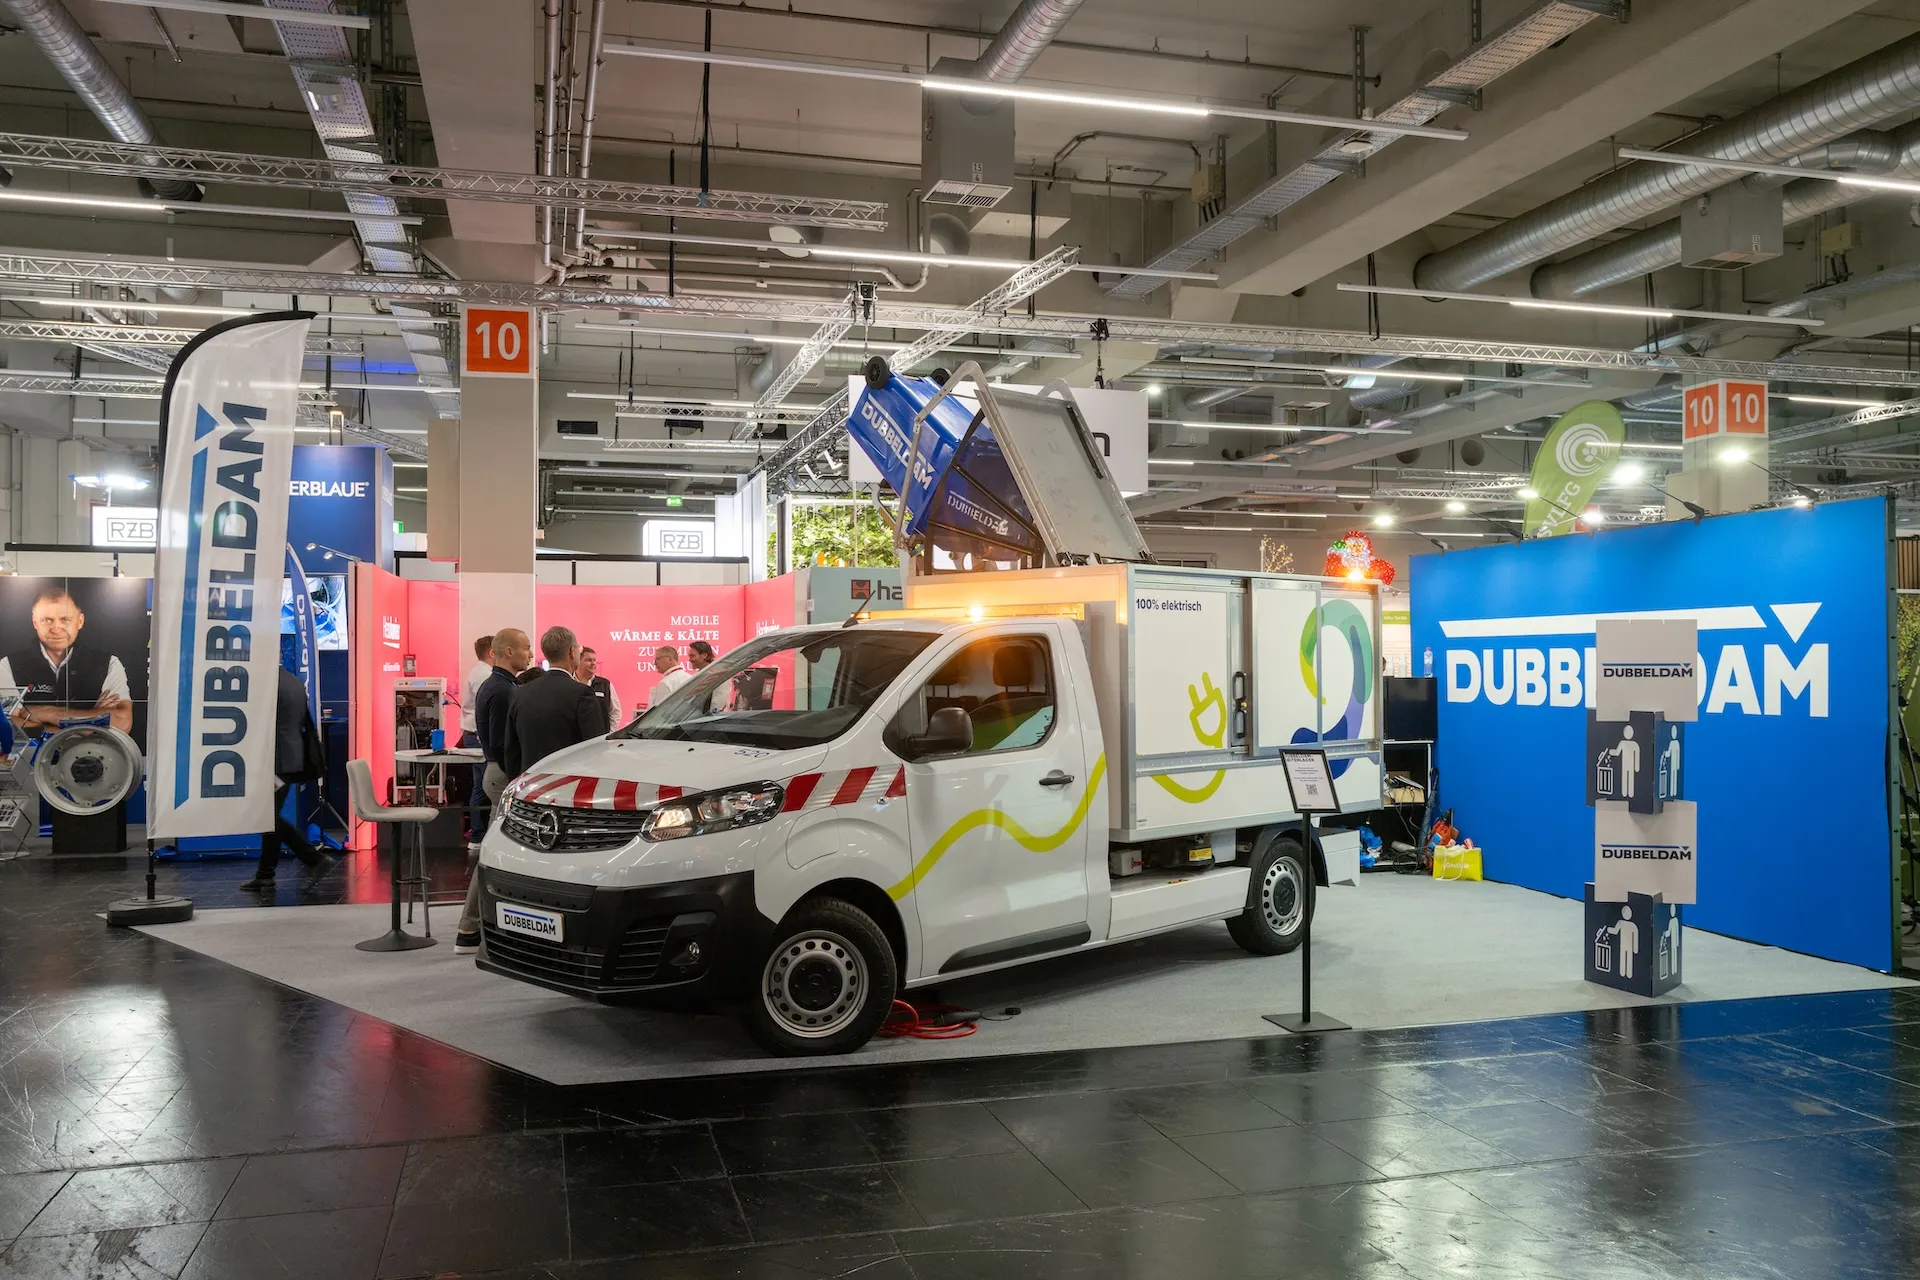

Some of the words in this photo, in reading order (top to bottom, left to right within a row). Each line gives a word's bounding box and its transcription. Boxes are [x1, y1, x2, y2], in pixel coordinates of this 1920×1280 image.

[475, 321, 521, 361] 10
[1689, 394, 1714, 428] 10
[1731, 392, 1760, 424] 10
[110, 521, 155, 539] RZB
[663, 534, 700, 550] RZB
[877, 580, 902, 600] ha
[201, 402, 268, 798] DUBBELDAM
[1136, 598, 1160, 610] 100%
[1161, 599, 1202, 612] elektrisch
[671, 615, 719, 626] MOBILE
[610, 629, 662, 641] WÄRME
[664, 632, 674, 641] &
[678, 629, 719, 641] KÄLTE
[637, 661, 658, 672] UN
[1602, 666, 1693, 679] DUBBELDAM
[1446, 643, 1829, 719] DUBBAM
[1602, 848, 1692, 861] DUBBELDAM
[504, 914, 556, 935] DUBBELDAM
